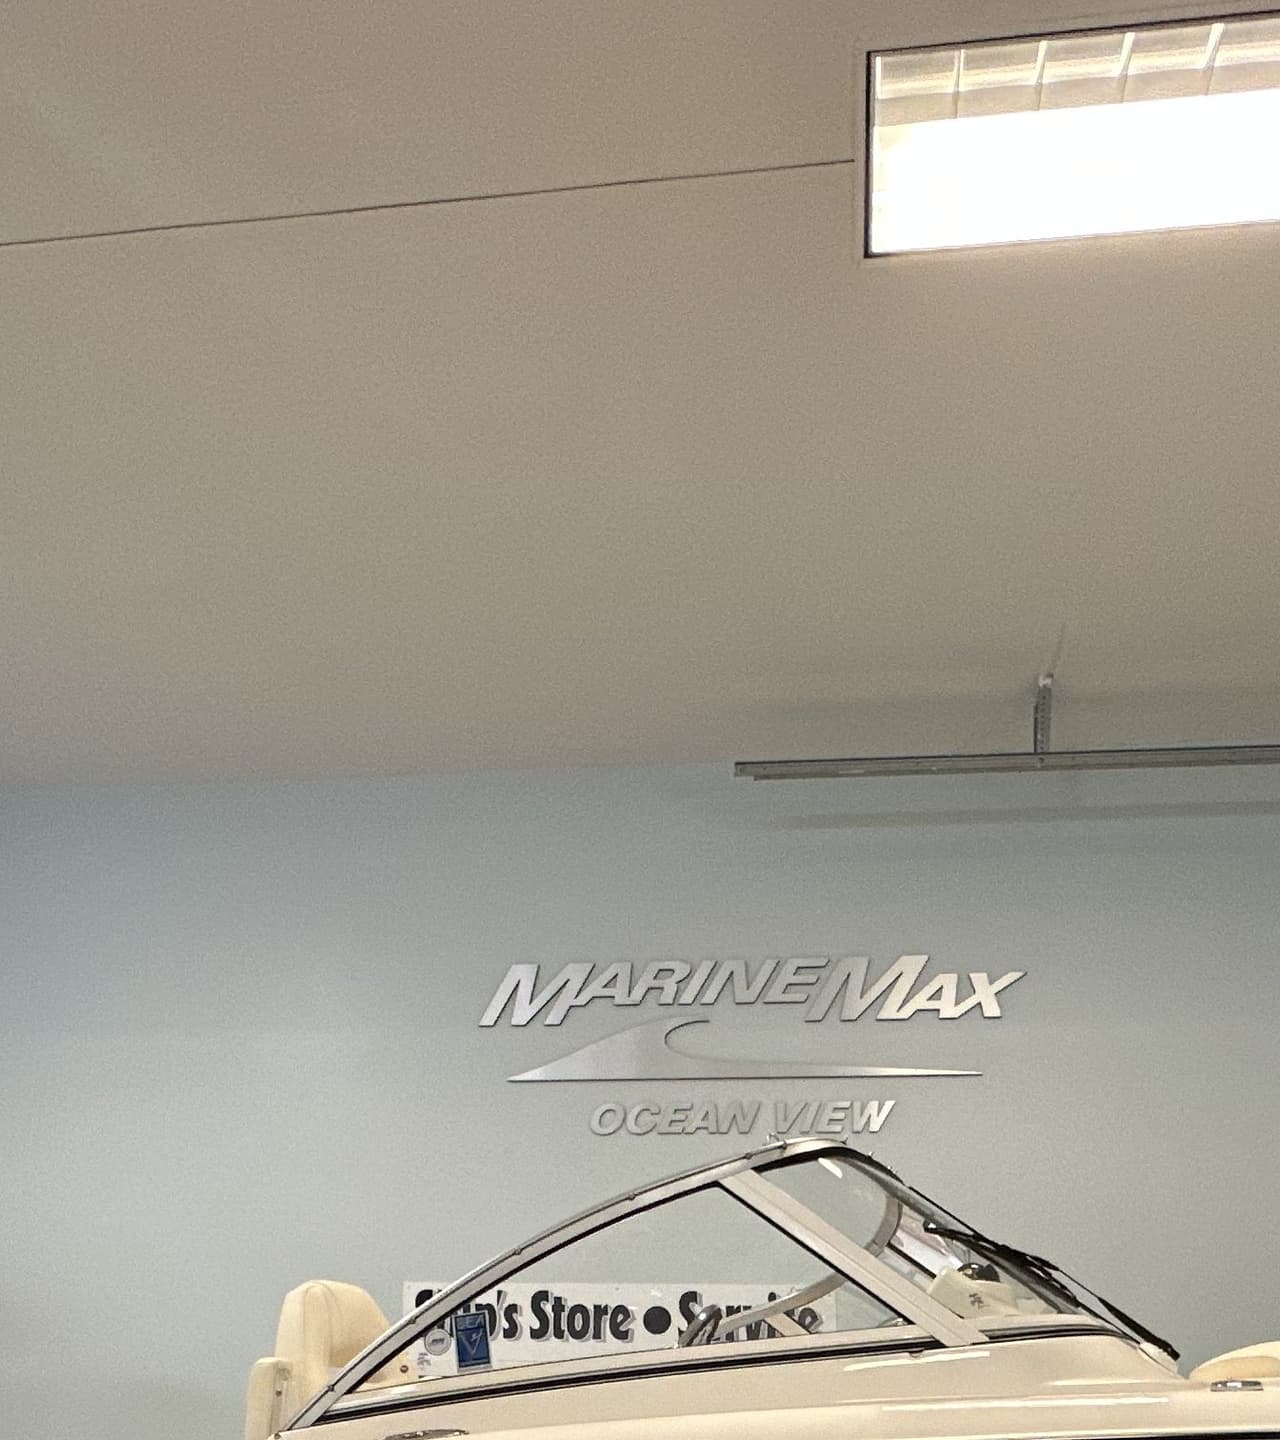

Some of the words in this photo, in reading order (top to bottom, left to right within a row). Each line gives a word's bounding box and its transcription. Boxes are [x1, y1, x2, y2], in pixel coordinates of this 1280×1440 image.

[589, 1101, 759, 1136] OCEAN
[773, 1099, 896, 1135] VIEW
[529, 1289, 633, 1341] Store
[678, 1290, 823, 1344] Srvie
